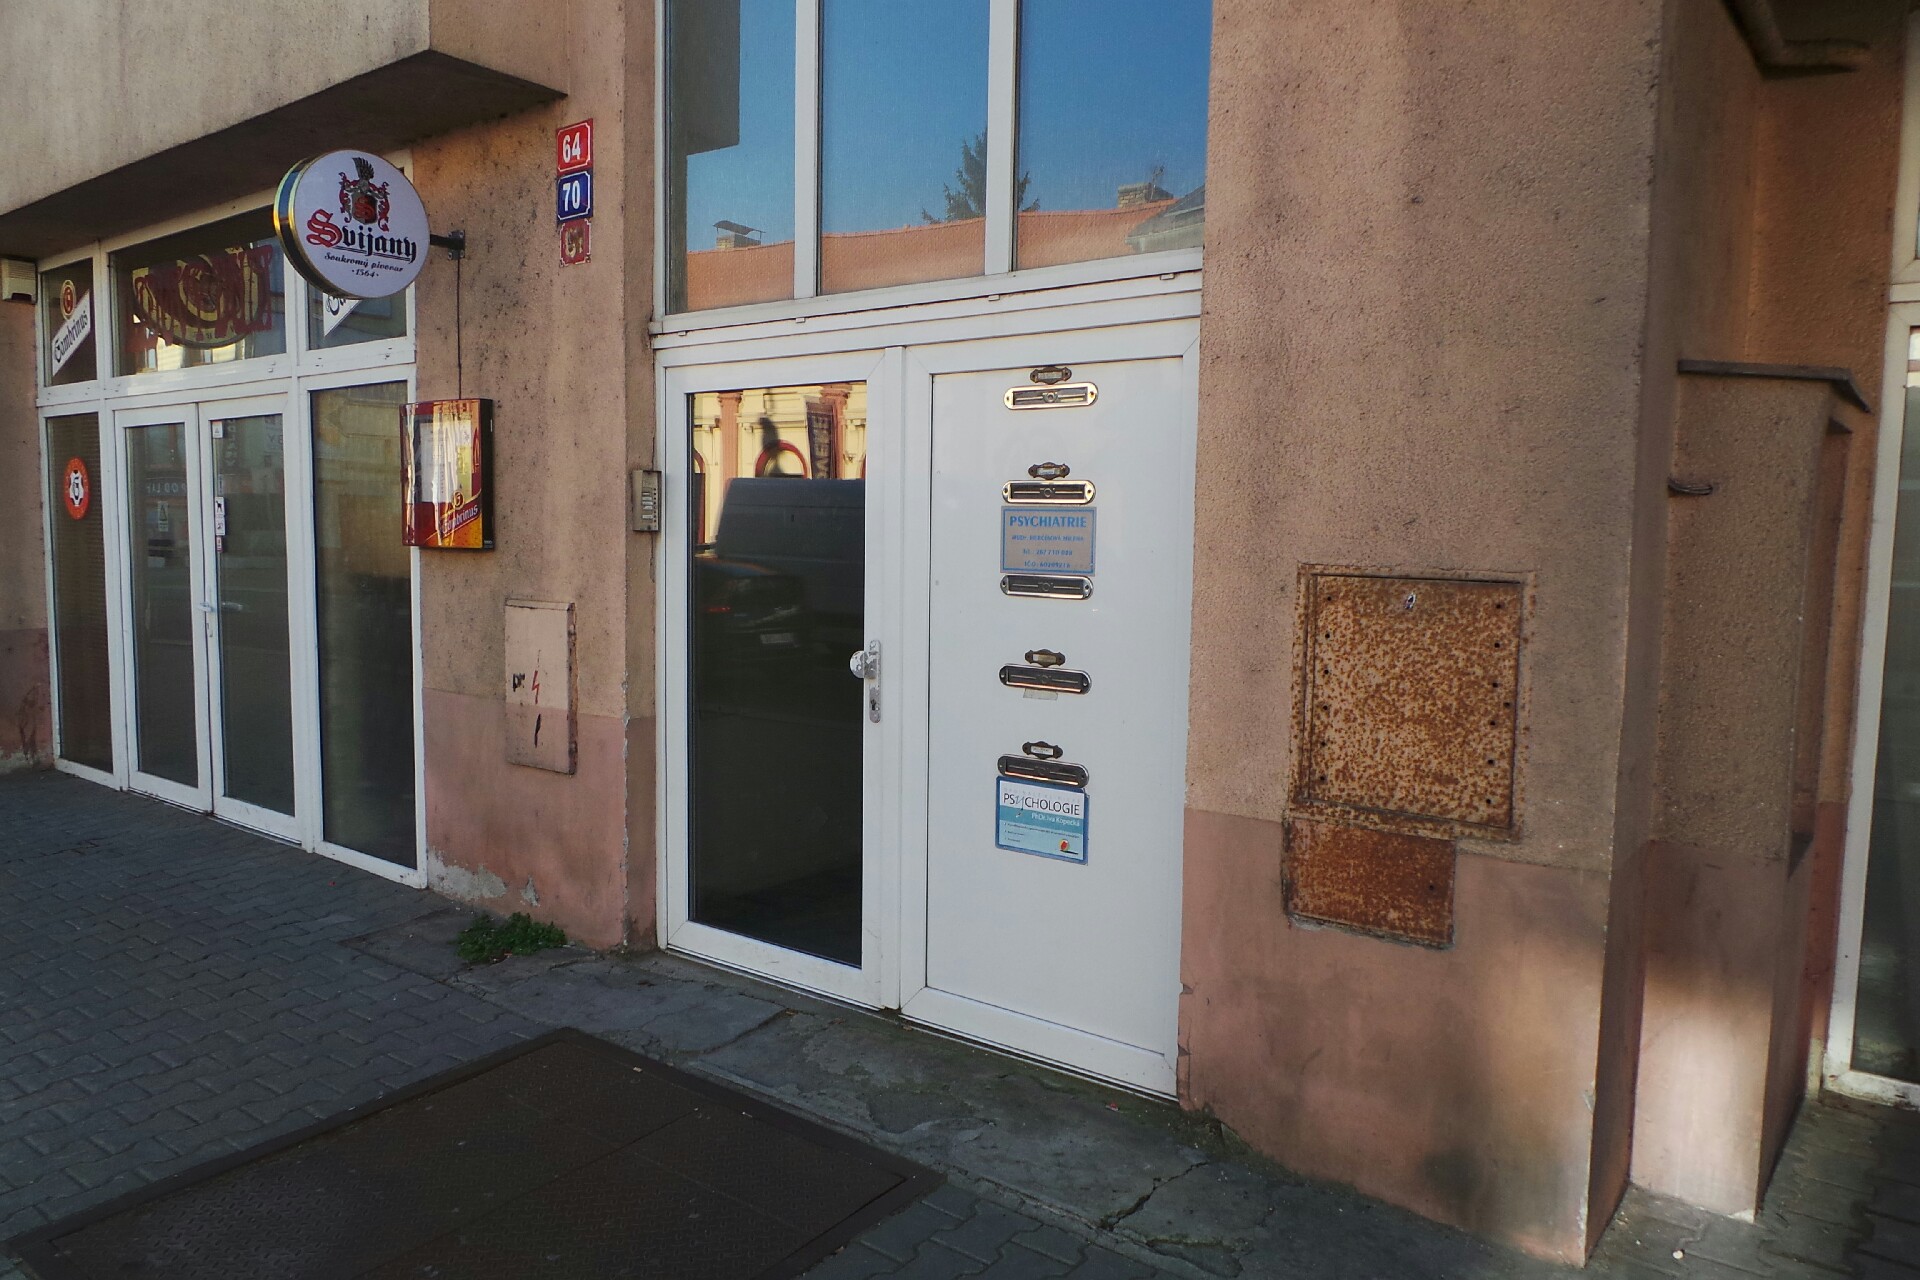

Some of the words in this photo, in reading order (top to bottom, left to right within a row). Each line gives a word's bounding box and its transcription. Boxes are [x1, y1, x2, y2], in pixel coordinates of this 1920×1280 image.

[562, 131, 581, 163] 64
[562, 180, 581, 212] 70
[306, 208, 417, 264] Svijany
[1009, 515, 1087, 528] PSYCHIATRIE
[1003, 792, 1080, 816] PSYCHOLOGIE
